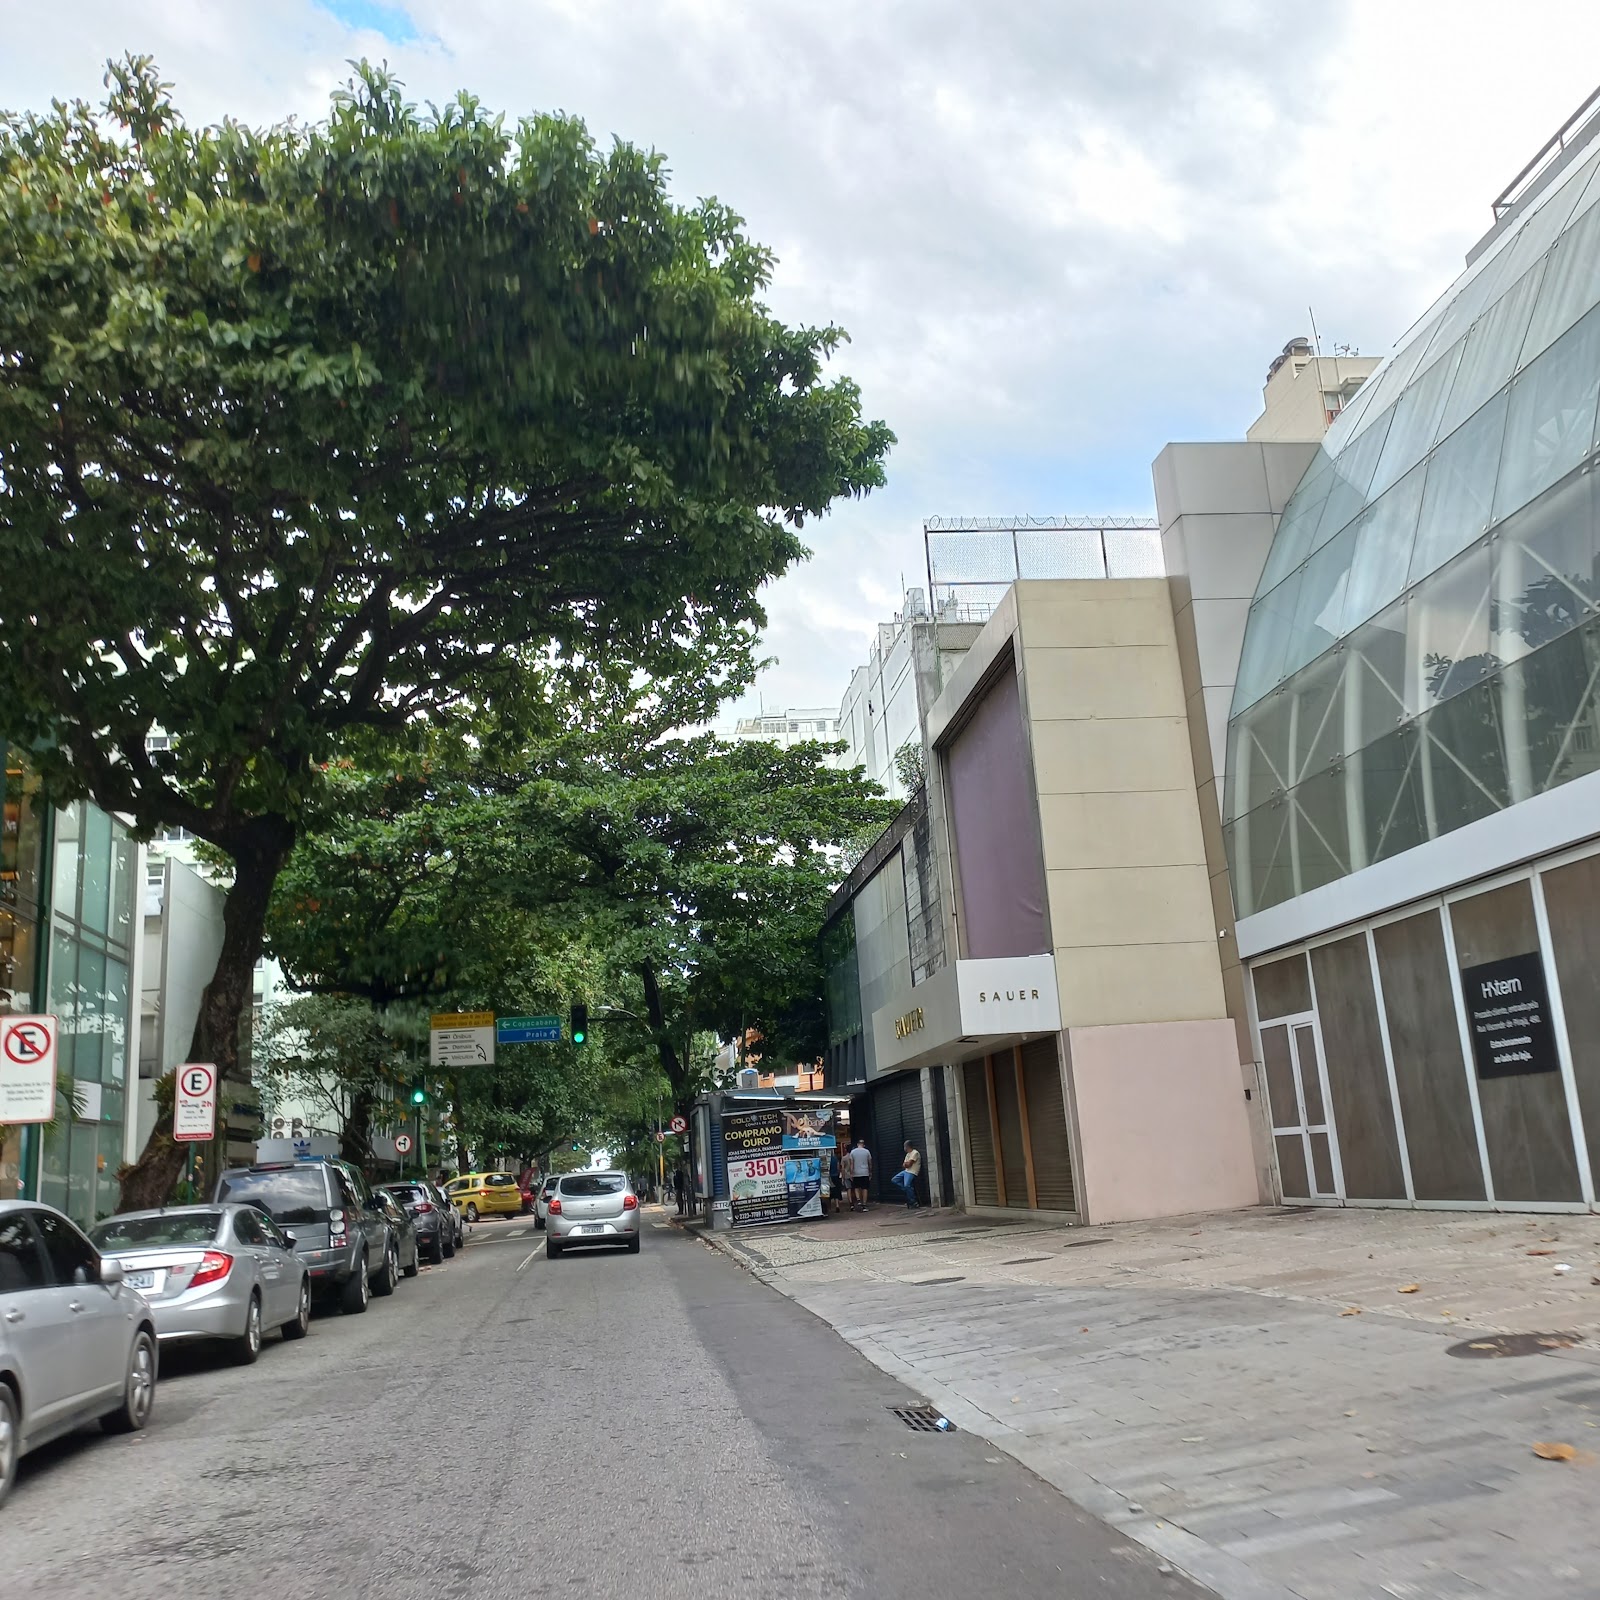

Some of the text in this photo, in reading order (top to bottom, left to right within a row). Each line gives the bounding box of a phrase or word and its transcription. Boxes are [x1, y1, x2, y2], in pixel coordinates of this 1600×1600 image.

[980, 989, 1040, 1002] SAUER
[894, 1007, 925, 1040] SAUER
[20, 1032, 36, 1054] E
[191, 1073, 202, 1090] E
[725, 1126, 782, 1140] COMPRAMO
[743, 1137, 771, 1147] OURO
